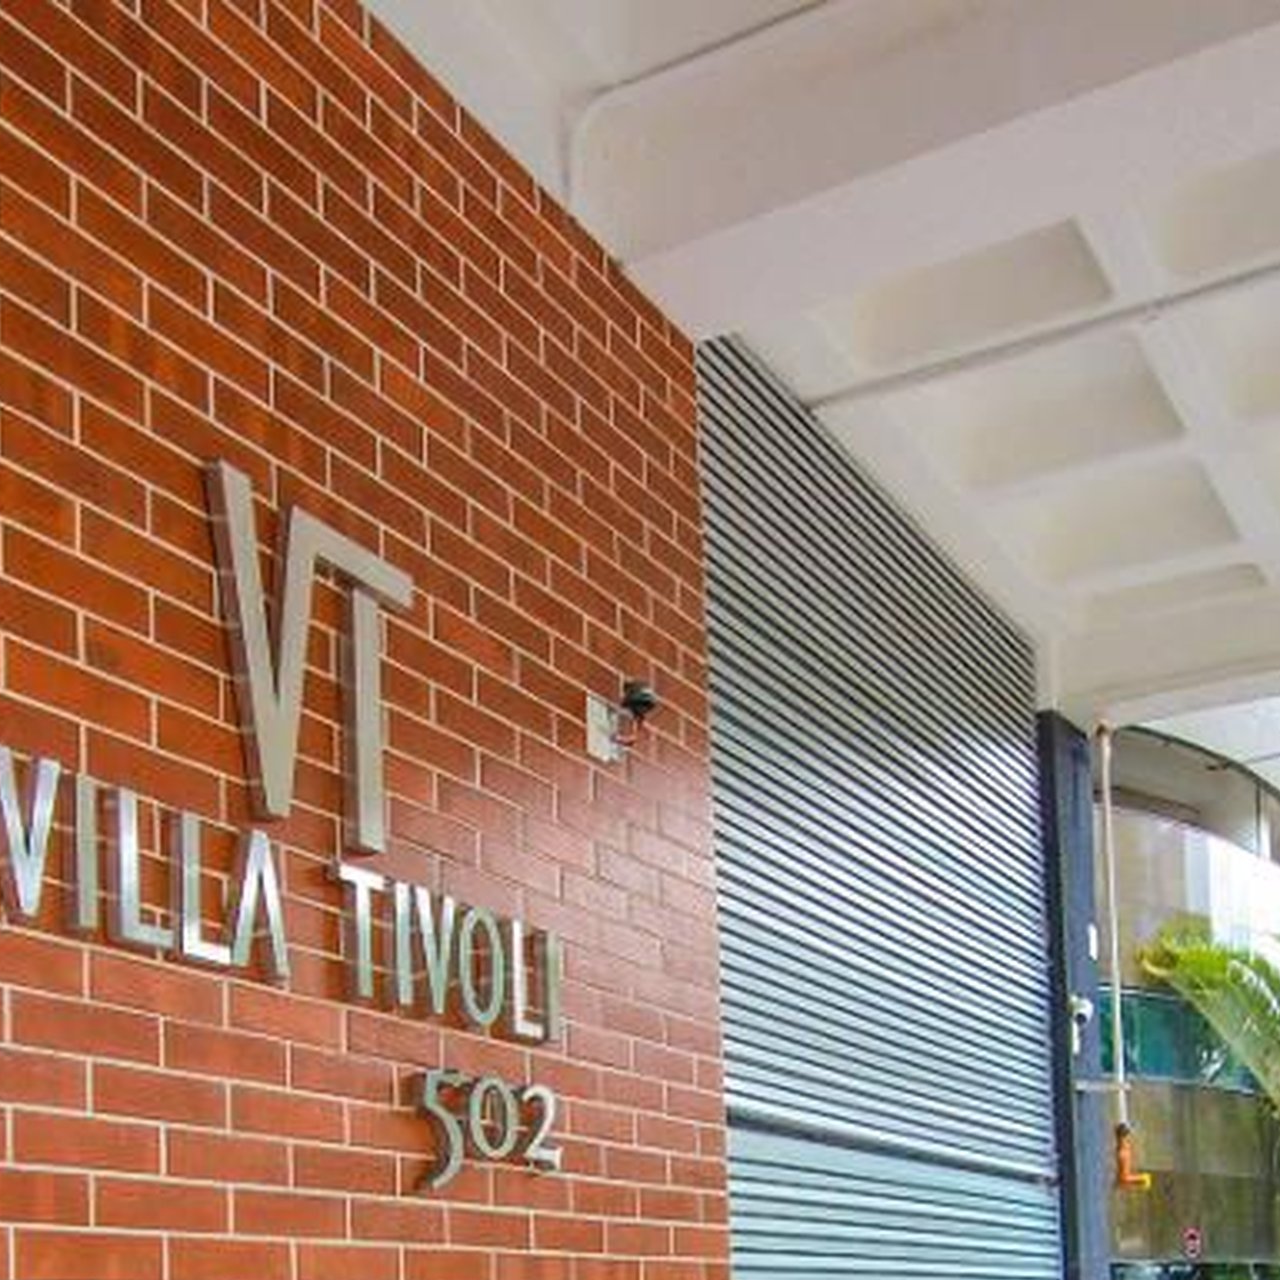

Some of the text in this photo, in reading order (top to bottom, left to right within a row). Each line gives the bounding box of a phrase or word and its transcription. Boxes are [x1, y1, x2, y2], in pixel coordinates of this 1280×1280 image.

[208, 459, 414, 855] VT
[338, 863, 562, 1045] TIVOLI
[415, 1070, 565, 1190] 502
